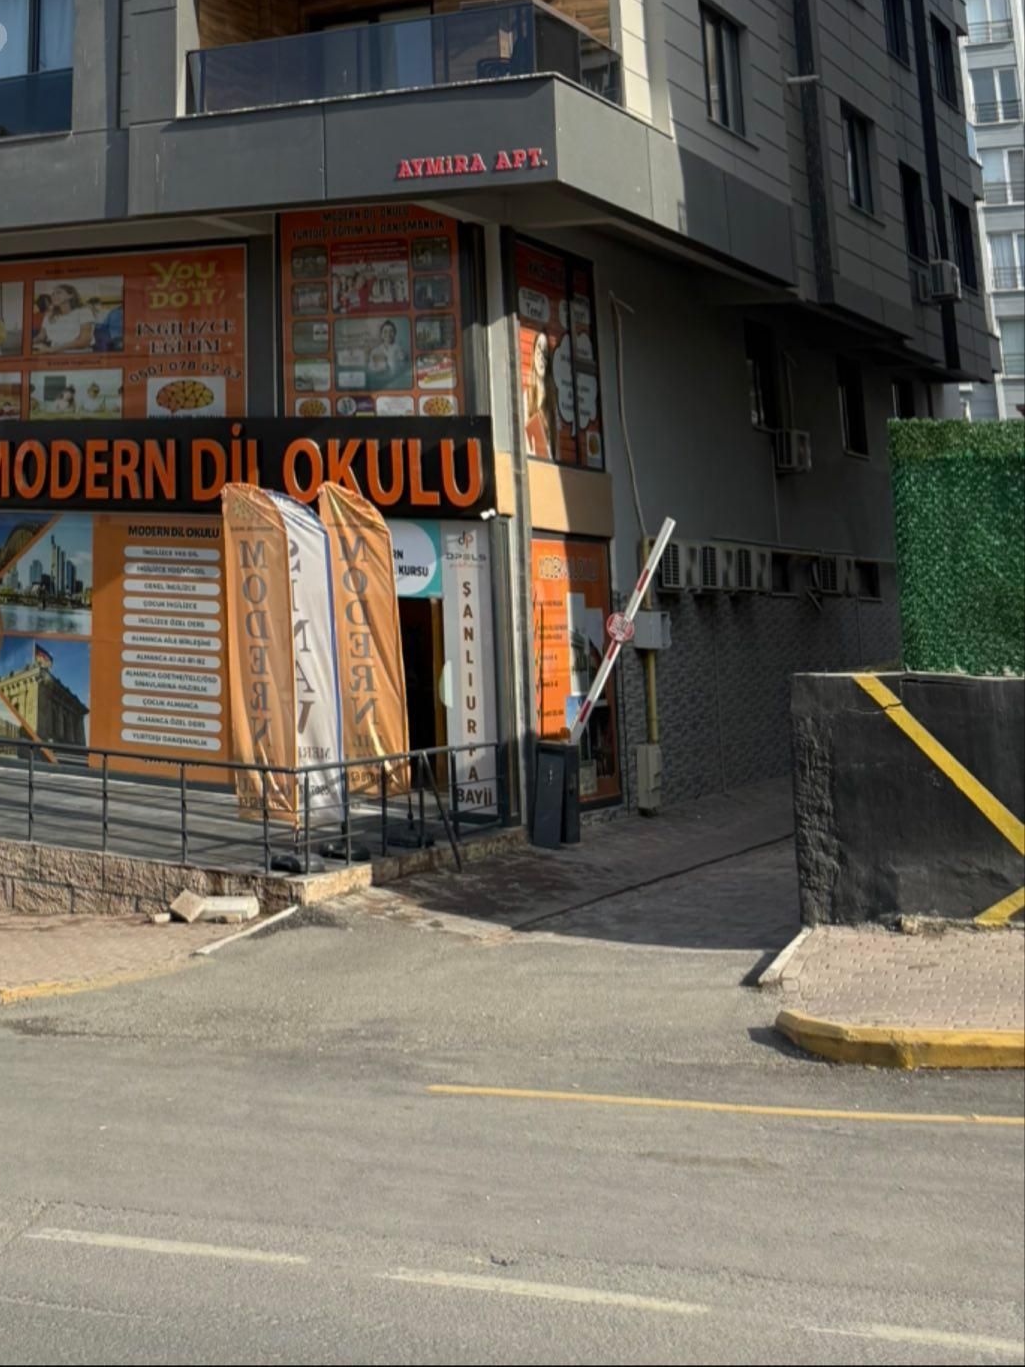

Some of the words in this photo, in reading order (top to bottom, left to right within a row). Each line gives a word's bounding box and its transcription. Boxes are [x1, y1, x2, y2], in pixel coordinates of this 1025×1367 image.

[495, 147, 549, 171] APT.
[150, 290, 189, 309] DO
[191, 423, 259, 502] DİL
[281, 437, 483, 507] OKULU
[128, 525, 170, 537] MODERN
[187, 527, 220, 539] OKULU
[398, 565, 429, 576] KURSU
[131, 635, 163, 643] ALMANCA
[136, 653, 167, 661] ALMANCA
[143, 698, 165, 707] ÇOCUK
[166, 700, 198, 709] ALMANCA
[137, 716, 168, 724] ALMANCA
[188, 720, 206, 728] DERS
